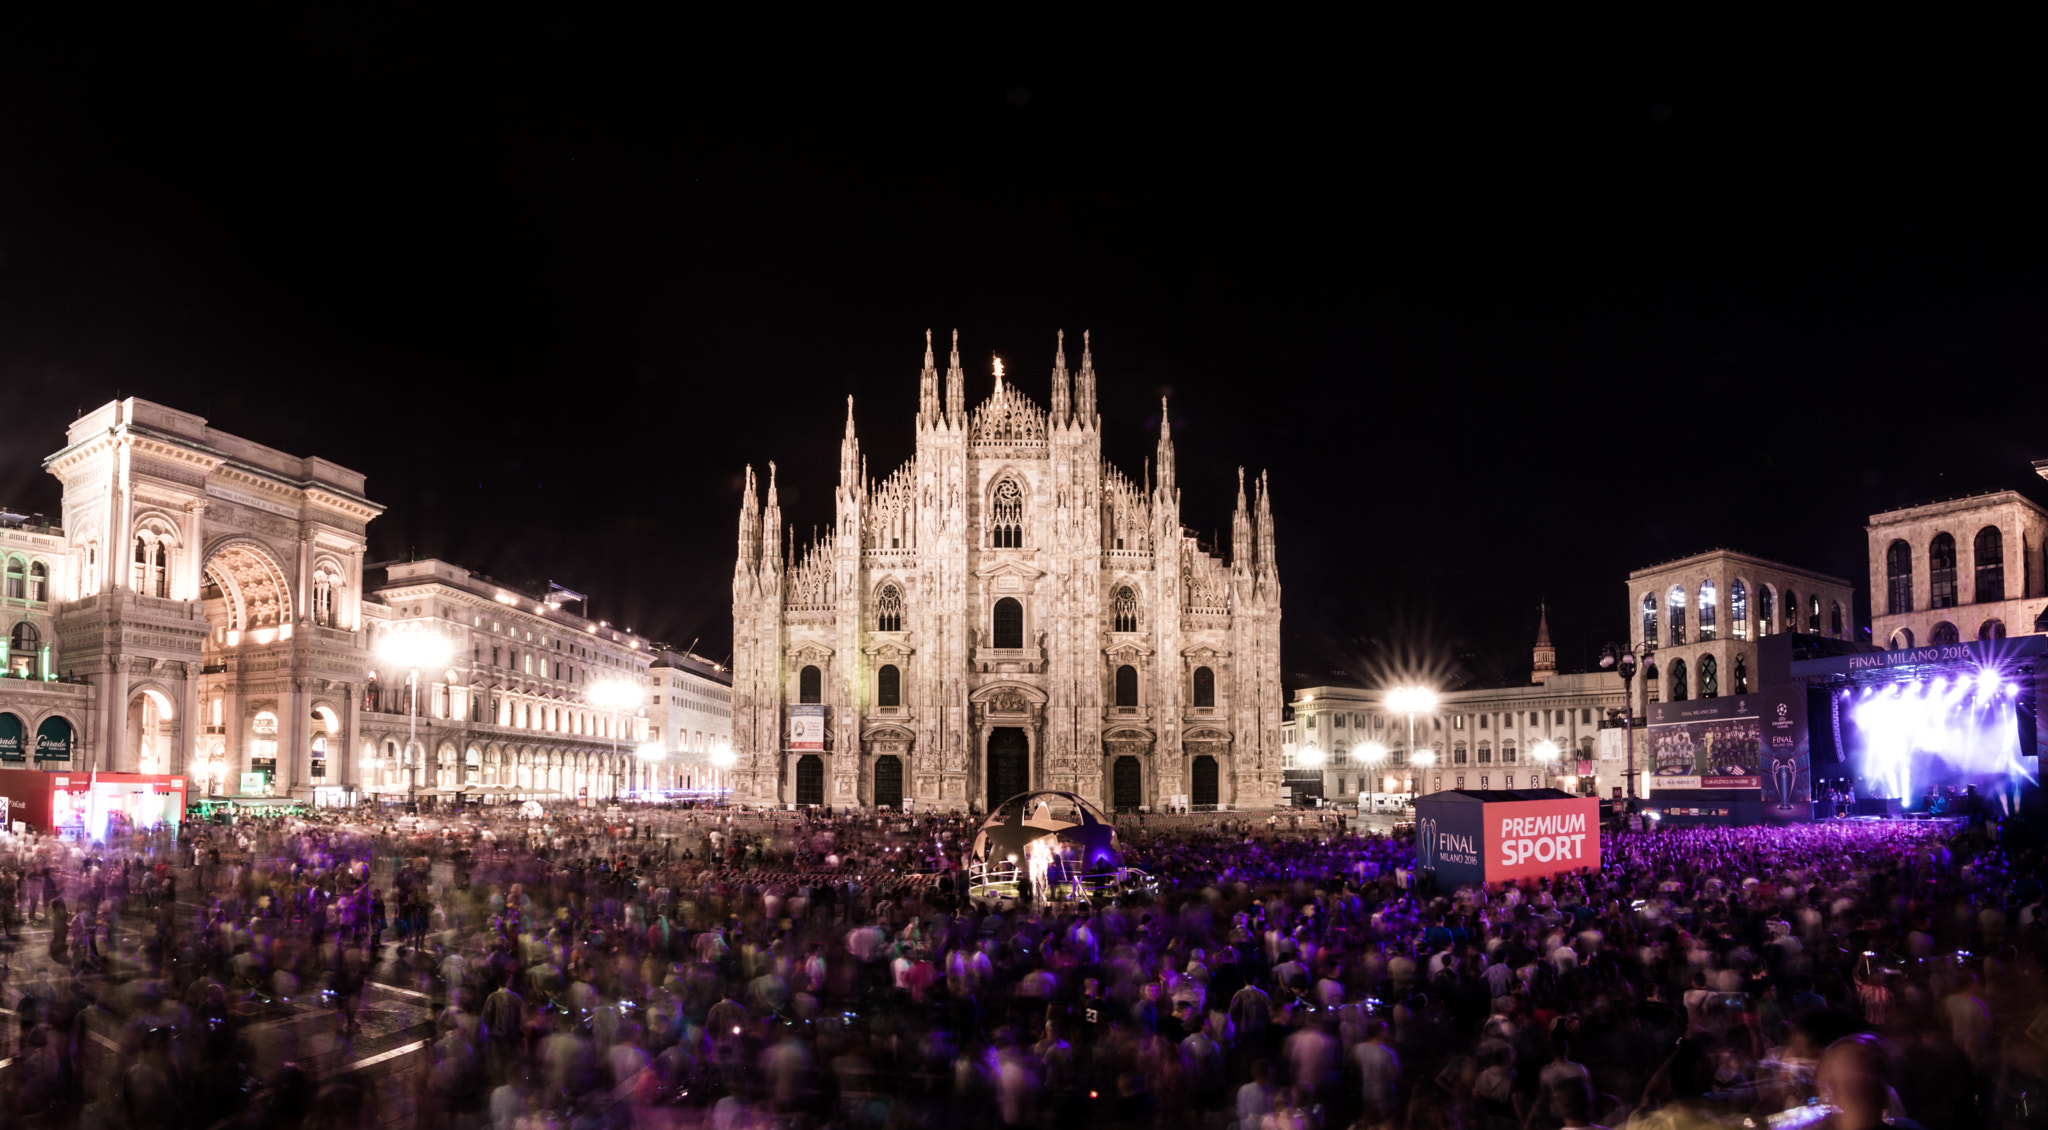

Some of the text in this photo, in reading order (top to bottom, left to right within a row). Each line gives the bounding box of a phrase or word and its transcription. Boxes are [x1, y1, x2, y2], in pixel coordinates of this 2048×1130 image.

[1849, 645, 1970, 669] FINAL MILANO 2016
[1501, 813, 1586, 838] PREMIUM
[1440, 833, 1477, 854] FINAL
[1501, 834, 1586, 865] SPORT
[1440, 852, 1478, 865] MILANO 2016
